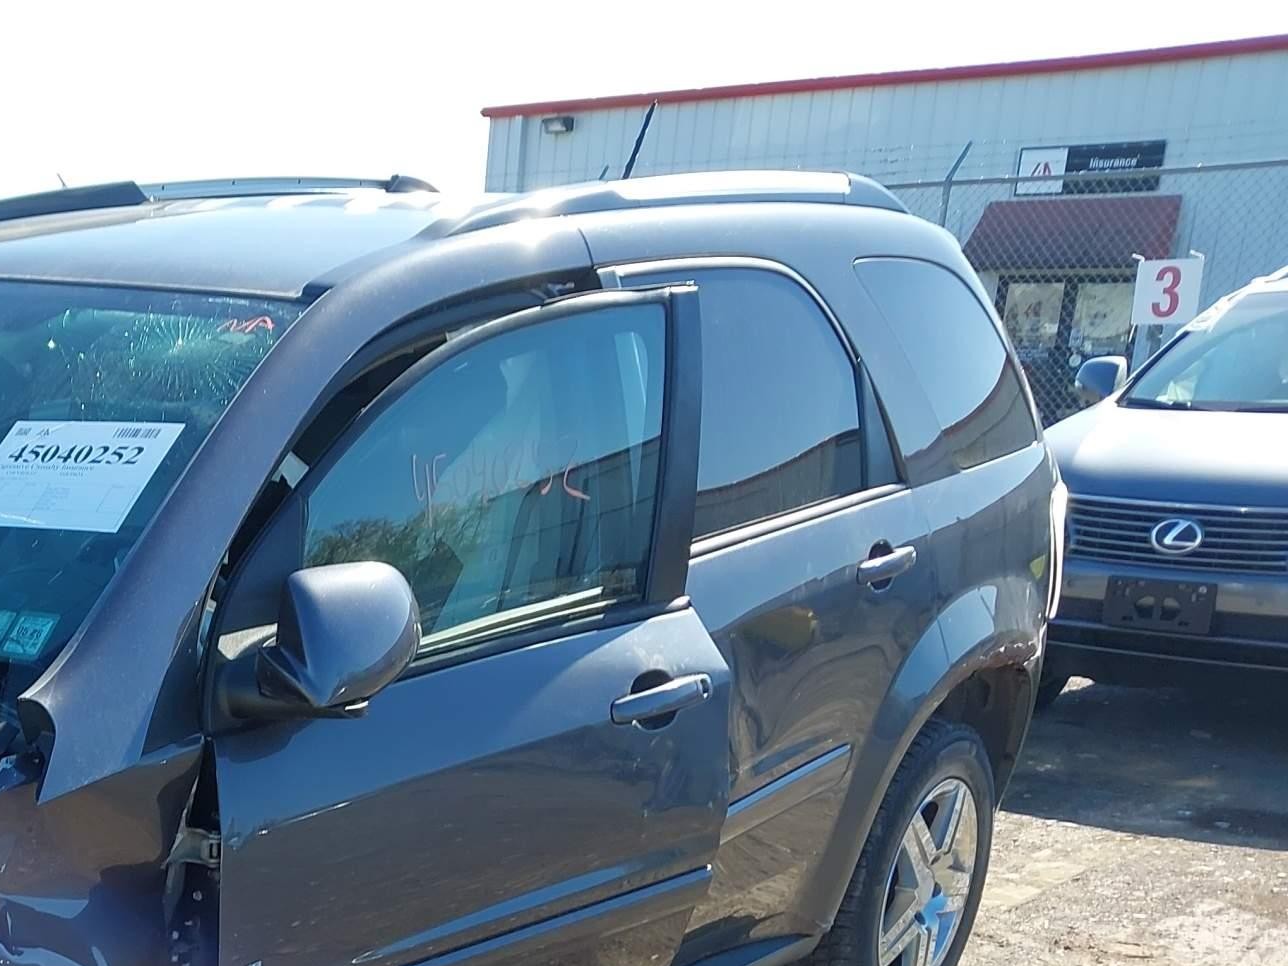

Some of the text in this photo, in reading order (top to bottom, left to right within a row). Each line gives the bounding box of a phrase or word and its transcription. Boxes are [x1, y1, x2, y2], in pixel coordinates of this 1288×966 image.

[1089, 156, 1138, 168] Insurance
[1151, 266, 1182, 319] 3
[8, 443, 145, 465] 45040252
